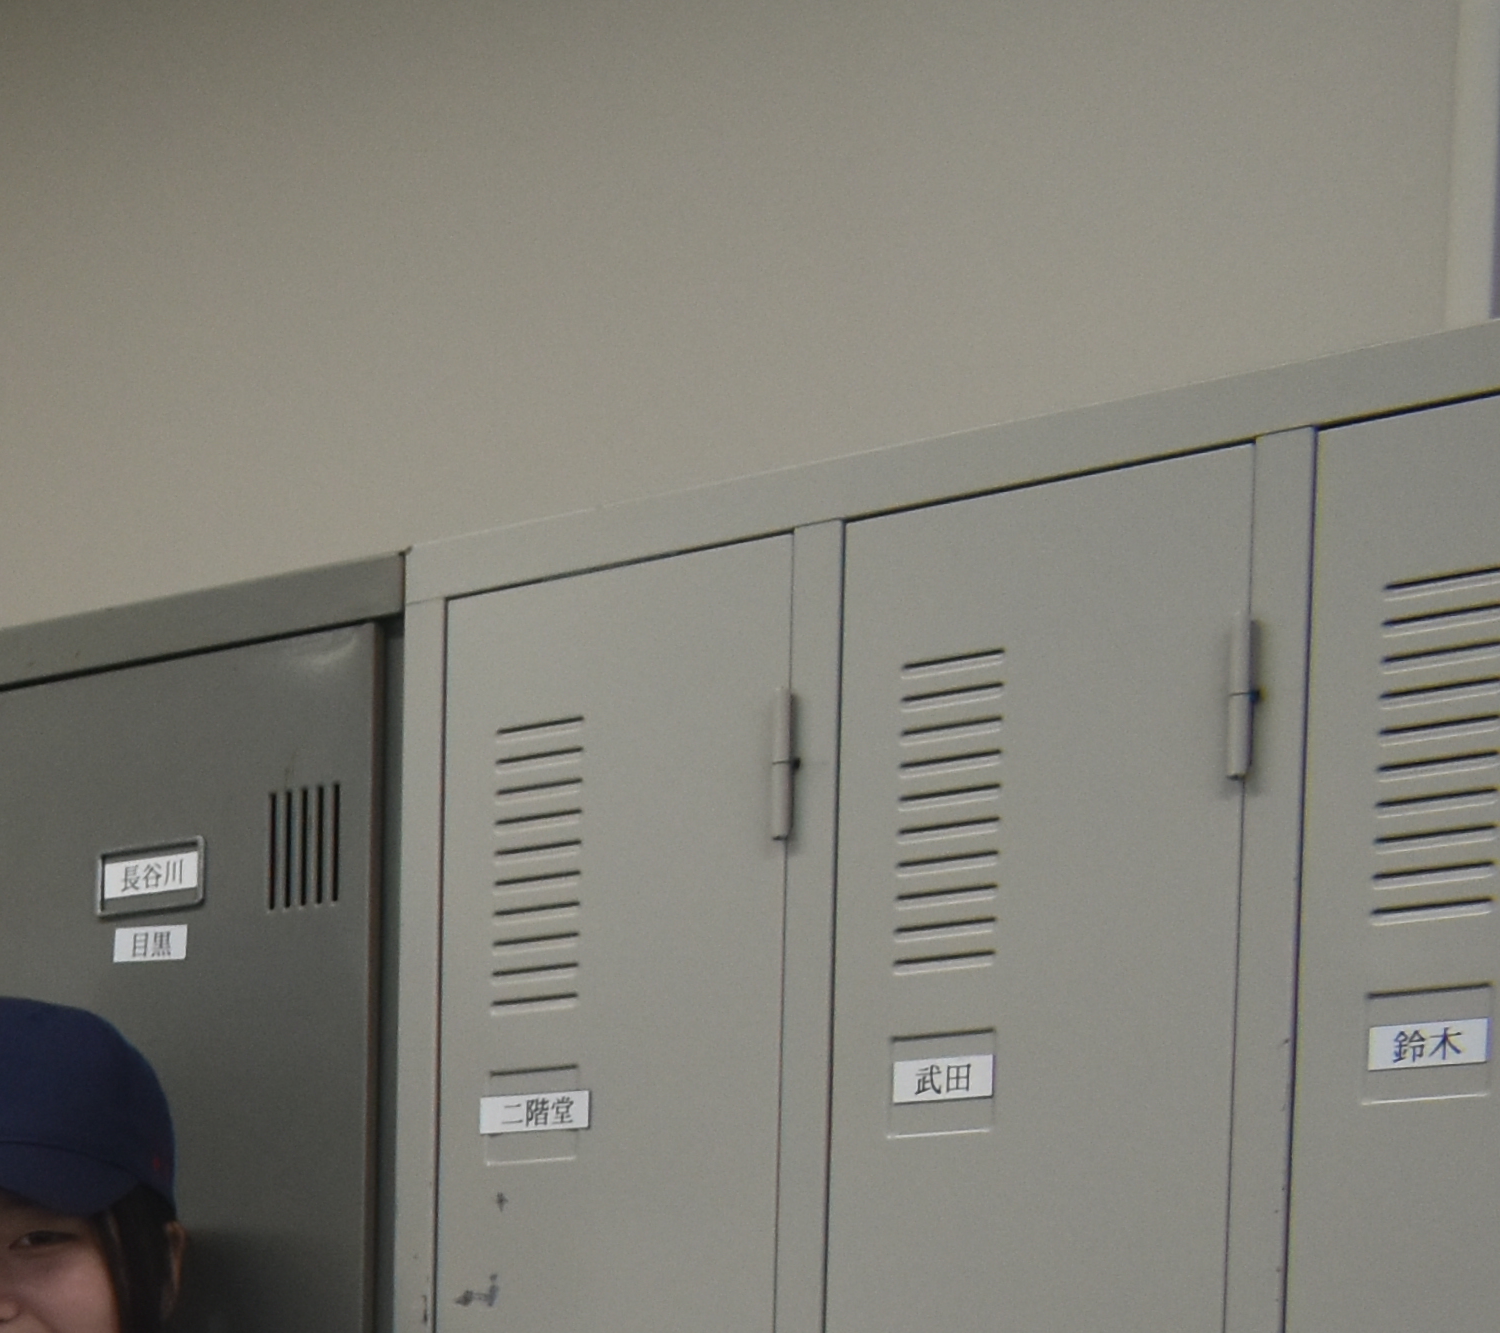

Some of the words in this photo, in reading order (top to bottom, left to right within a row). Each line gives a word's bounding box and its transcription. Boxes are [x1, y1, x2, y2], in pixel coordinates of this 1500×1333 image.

[121, 859, 184, 892] 長谷川
[132, 930, 172, 958] 目黒
[1393, 1027, 1463, 1065] 鈴木
[913, 1063, 973, 1096] 武田
[501, 1096, 576, 1129] 二階堂
